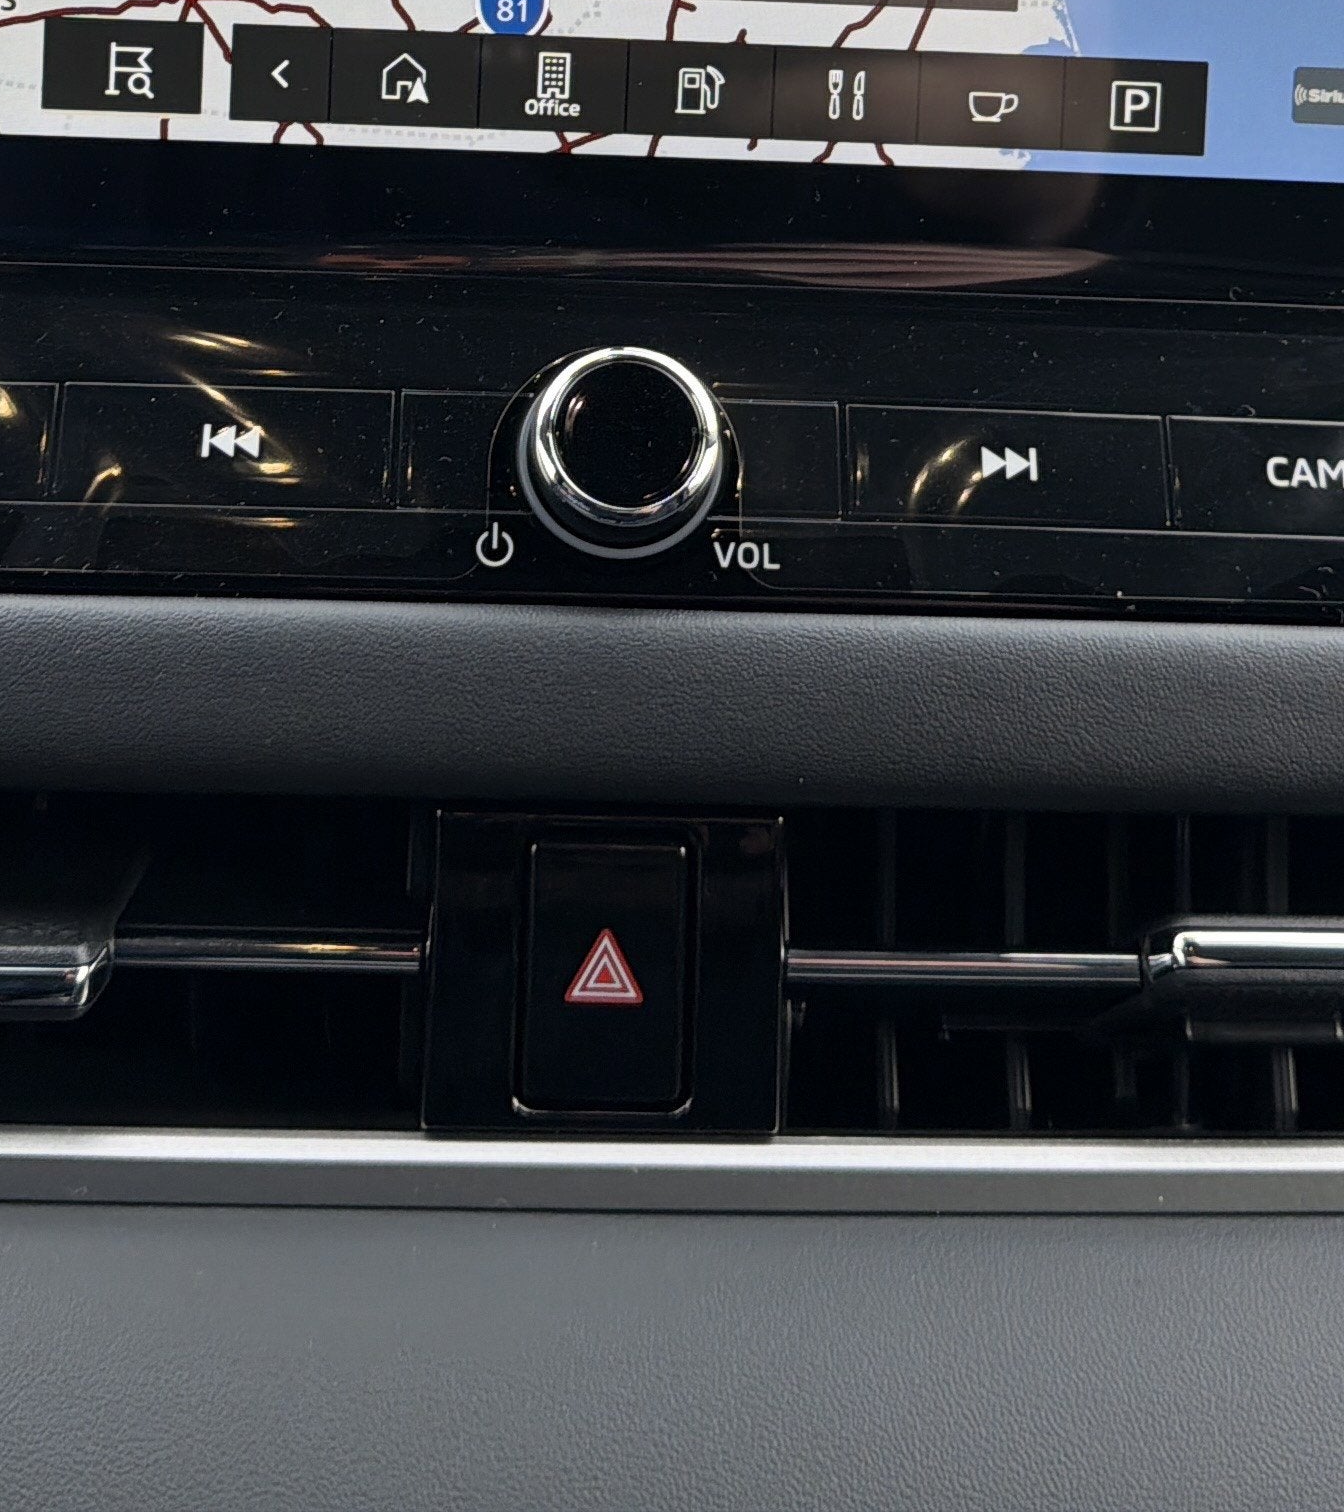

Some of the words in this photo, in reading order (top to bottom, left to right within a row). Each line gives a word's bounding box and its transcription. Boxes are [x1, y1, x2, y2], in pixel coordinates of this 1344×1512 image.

[524, 98, 580, 117] Office
[1123, 90, 1150, 123] P
[714, 541, 780, 570] VOL
